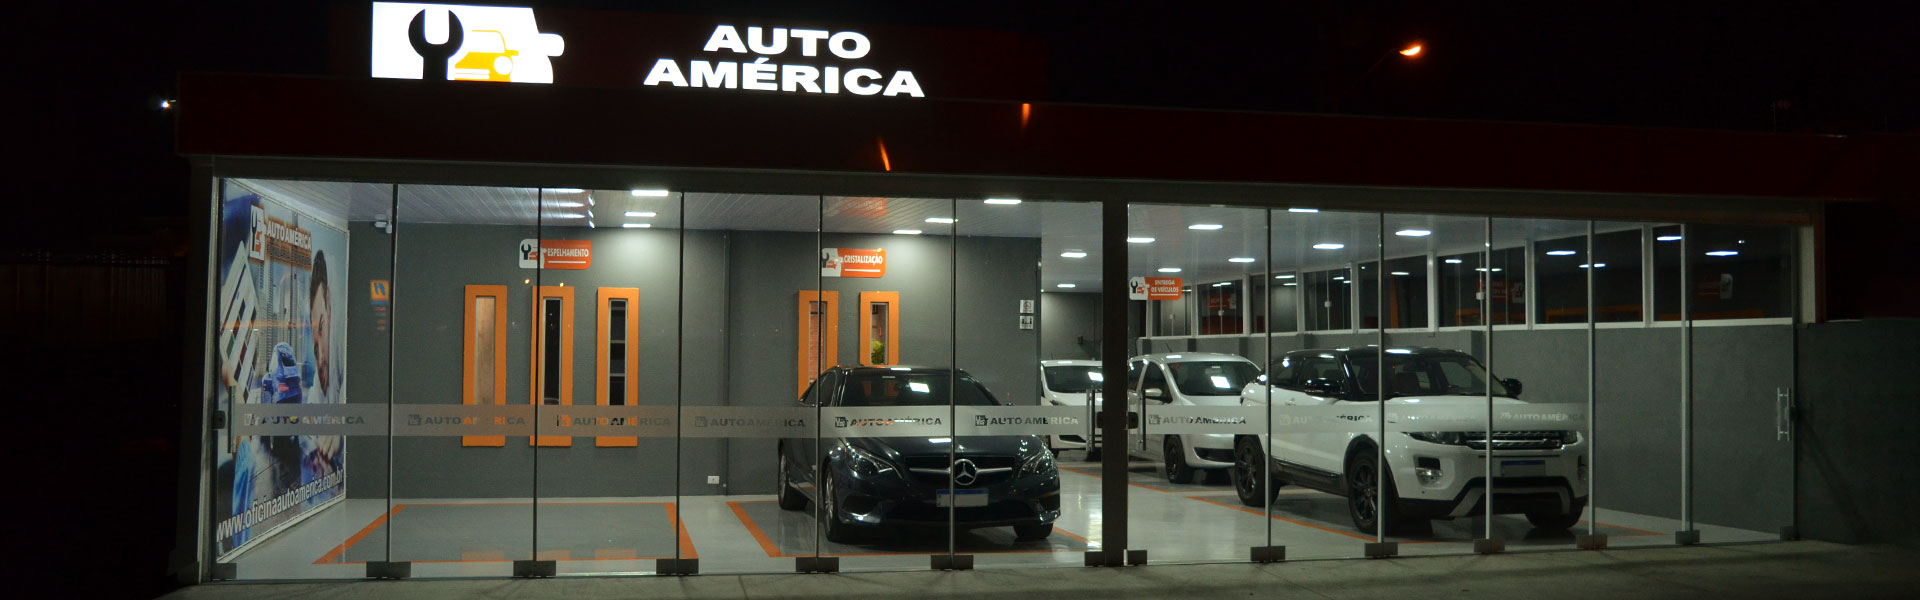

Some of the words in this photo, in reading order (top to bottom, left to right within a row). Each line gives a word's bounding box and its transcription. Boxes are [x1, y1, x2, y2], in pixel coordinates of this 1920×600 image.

[703, 25, 871, 59] AUTO
[643, 57, 926, 98] AMÉRICA
[547, 248, 589, 257] ESPELHAMENTO
[844, 253, 883, 266] CRISTALIZAÇÃO
[216, 466, 344, 542] www.oficinaautoamerica.com.br
